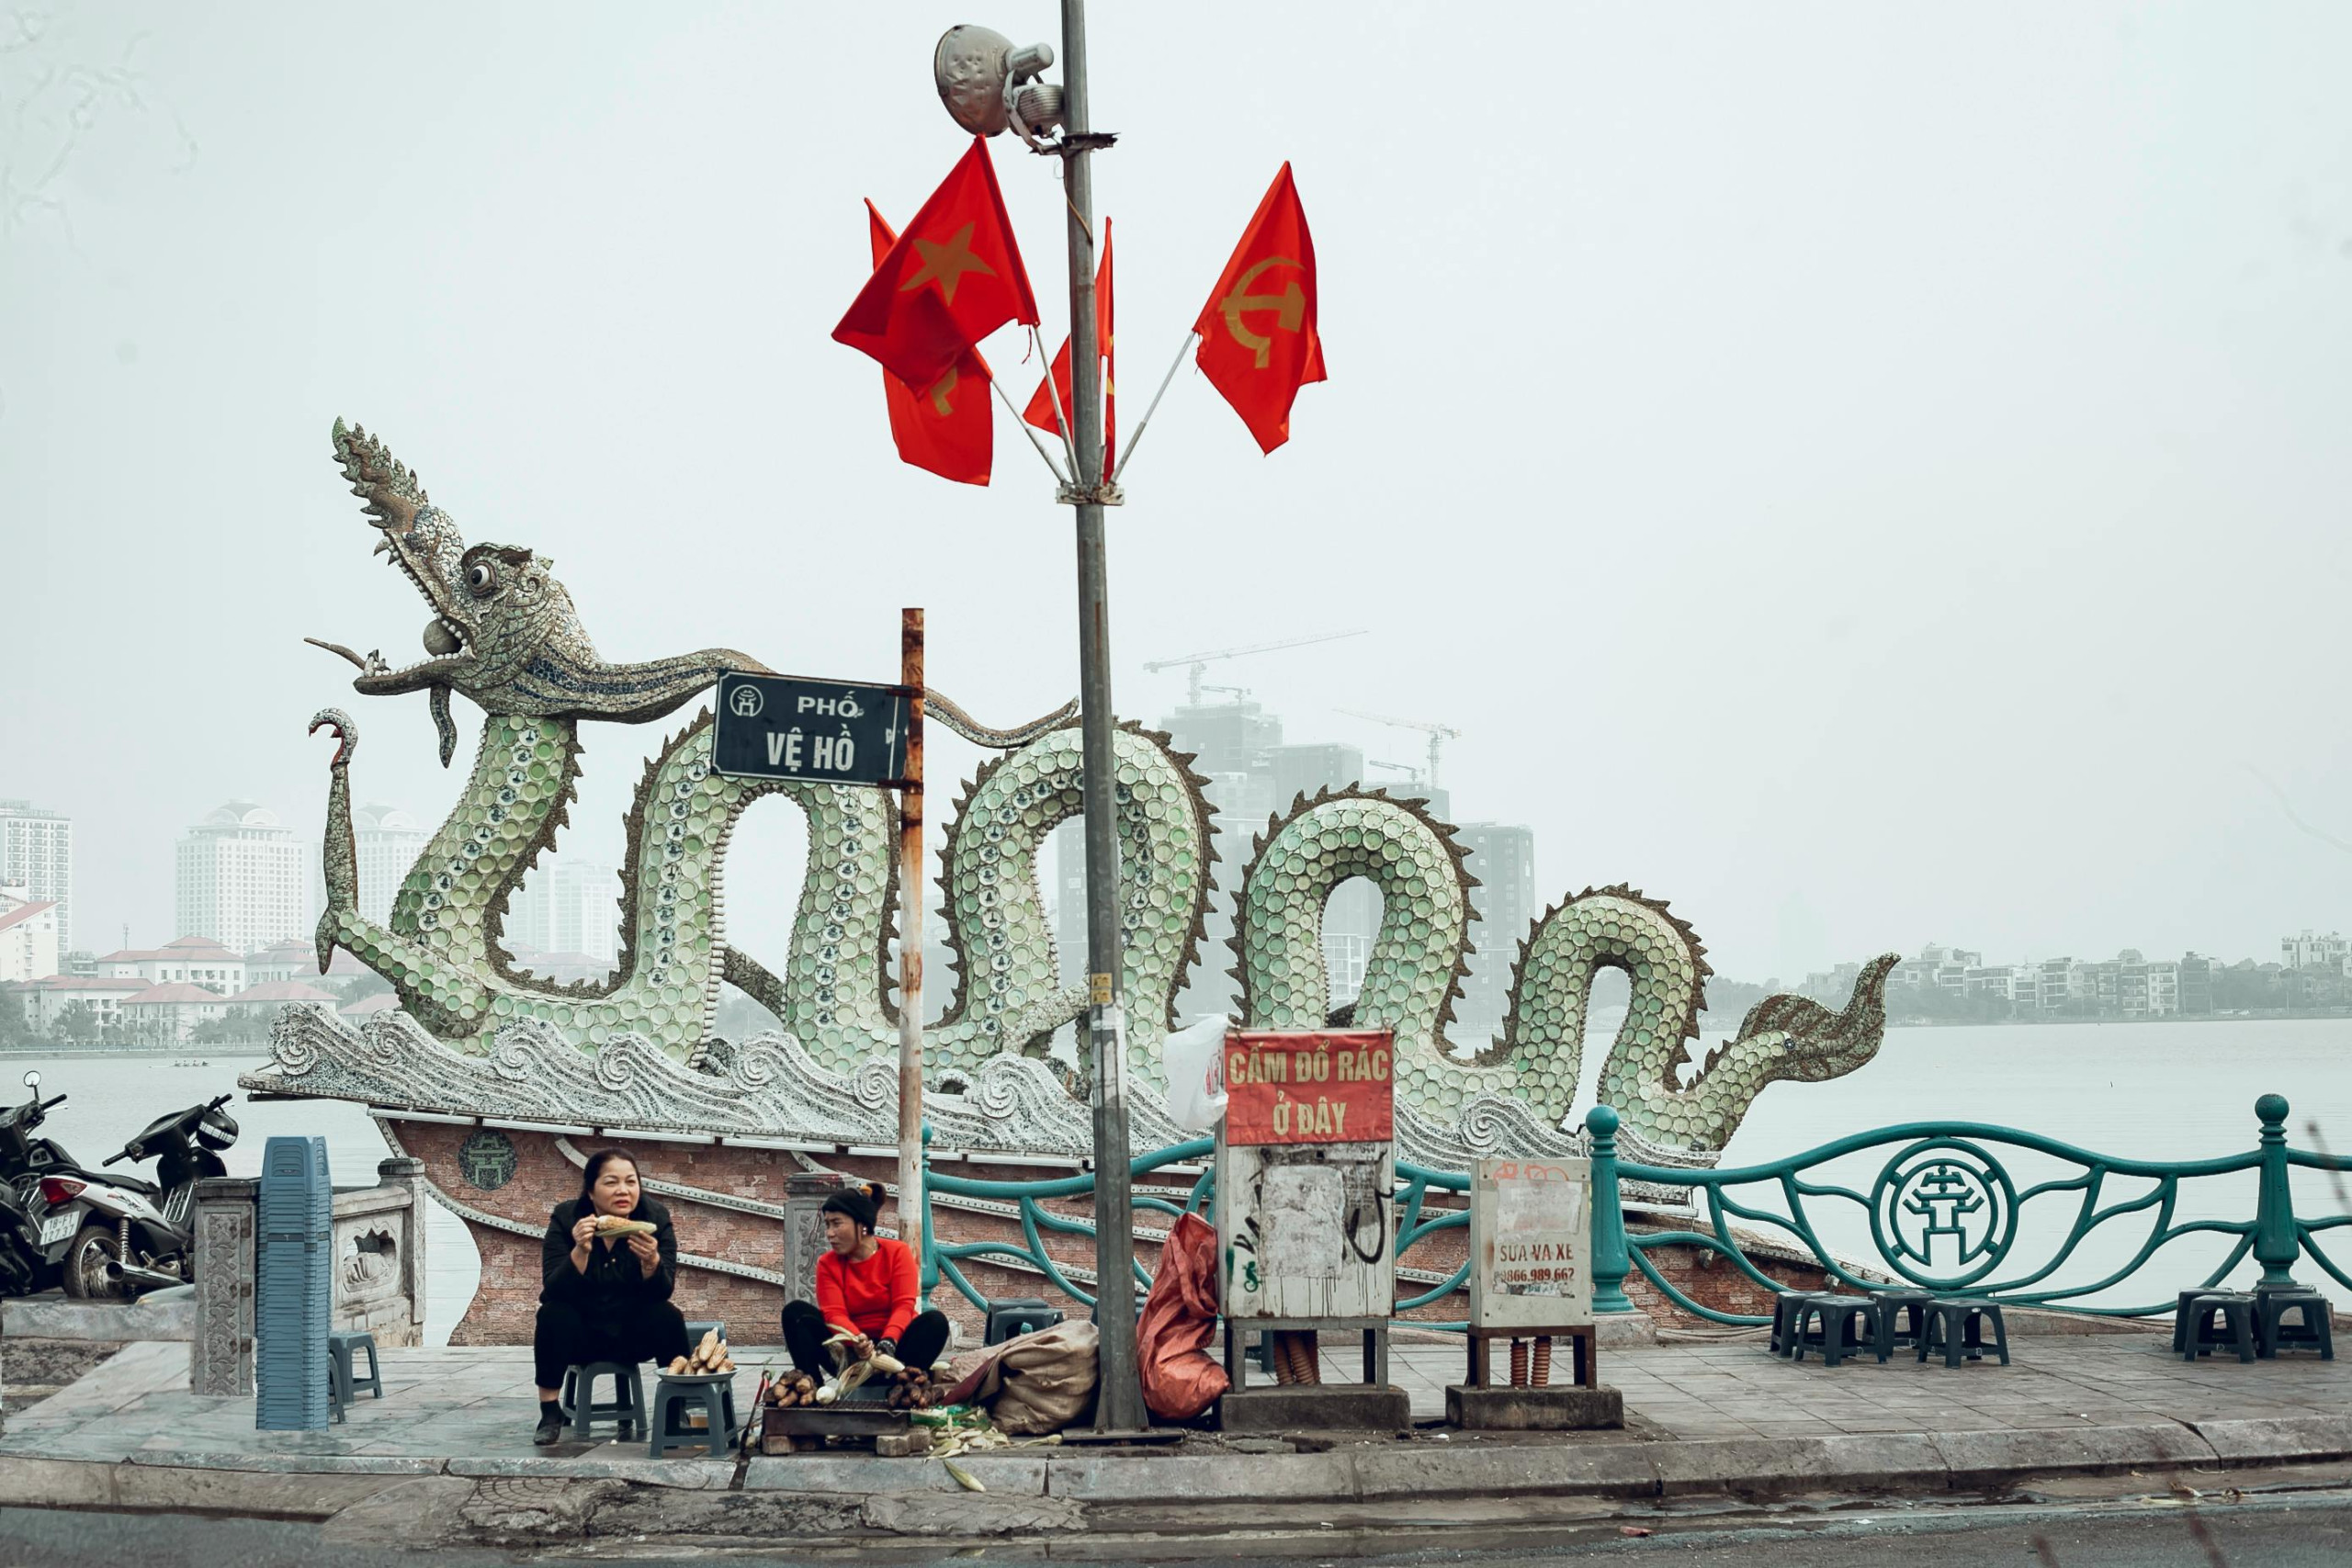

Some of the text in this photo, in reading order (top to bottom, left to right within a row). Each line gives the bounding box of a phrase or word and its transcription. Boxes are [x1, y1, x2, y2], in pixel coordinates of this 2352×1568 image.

[797, 691, 859, 718] PHỐ
[766, 723, 854, 773] VỆ HỒ
[1229, 1042, 1286, 1085] CẤM
[1295, 1040, 1330, 1082] ĐỔ
[1338, 1043, 1388, 1082] RÁC
[1273, 1090, 1347, 1135] Ở ĐÂY
[1555, 1244, 1574, 1261] XE
